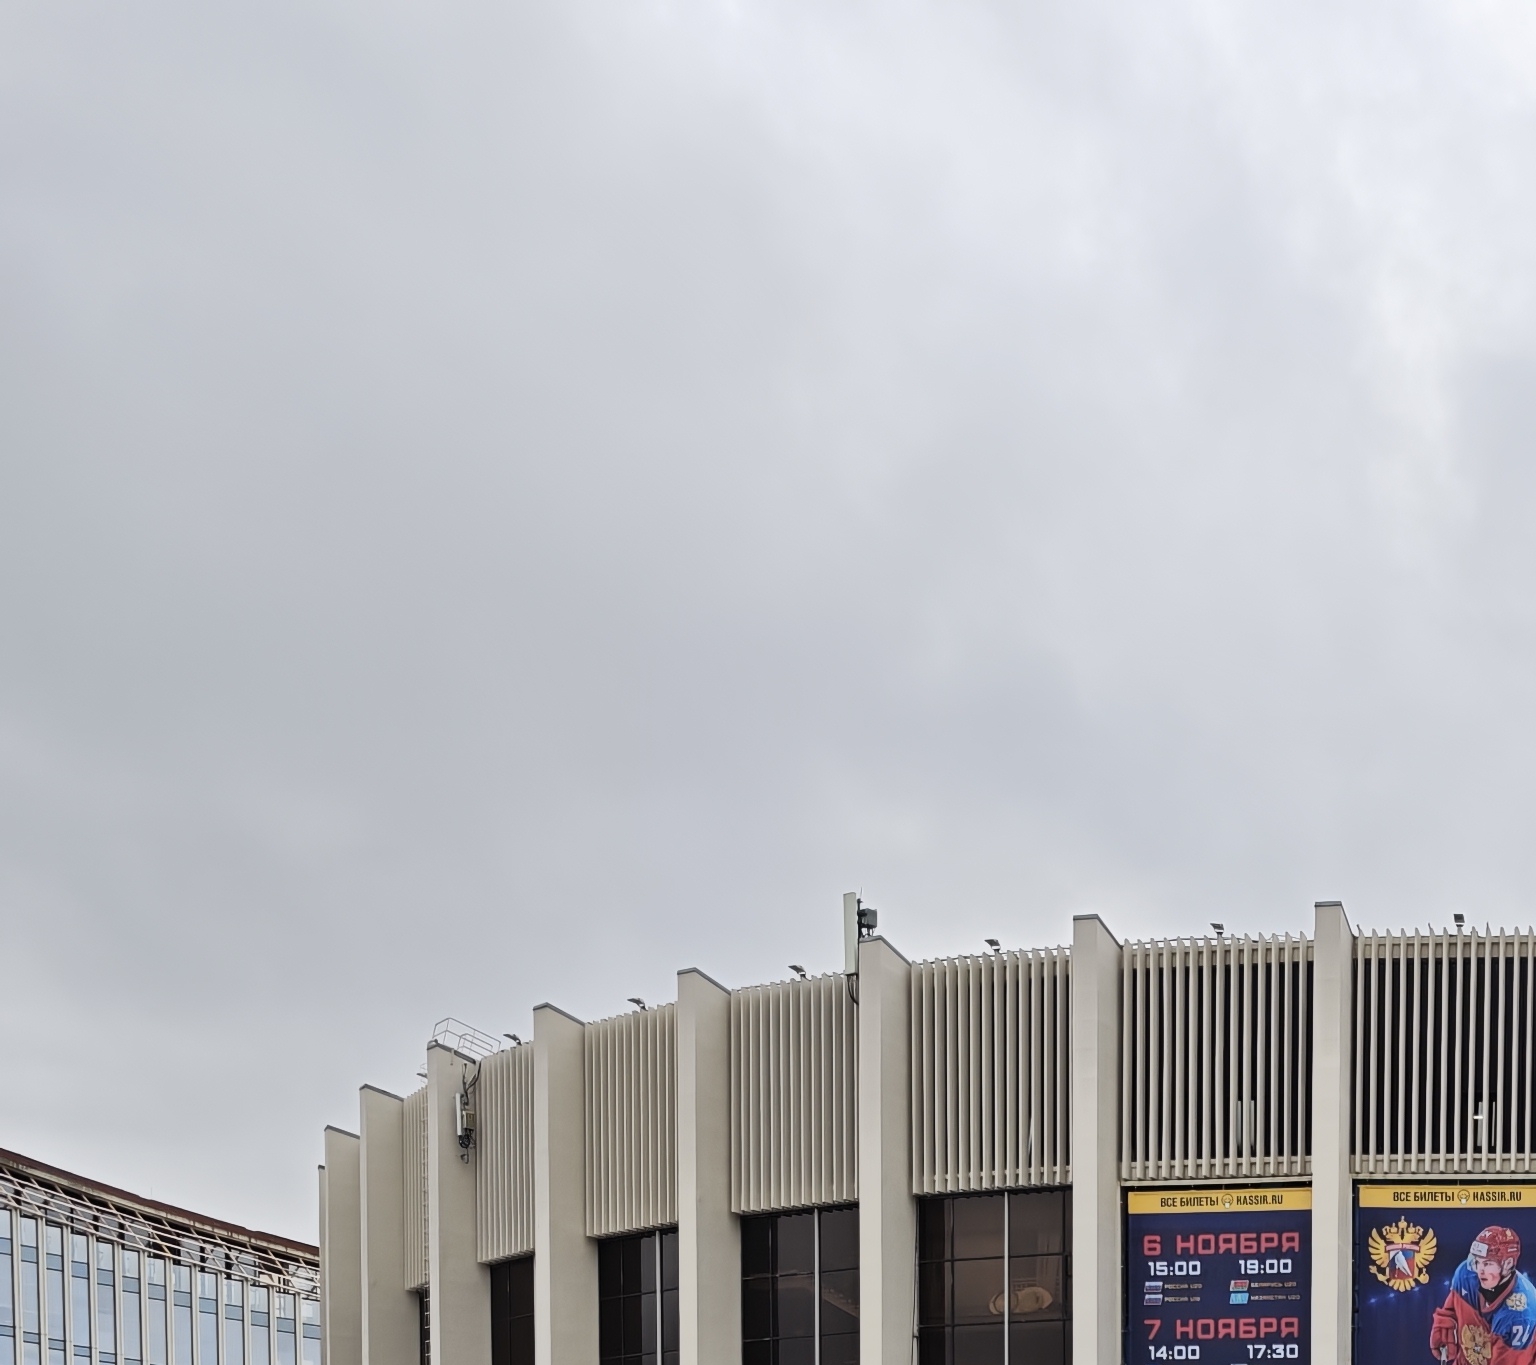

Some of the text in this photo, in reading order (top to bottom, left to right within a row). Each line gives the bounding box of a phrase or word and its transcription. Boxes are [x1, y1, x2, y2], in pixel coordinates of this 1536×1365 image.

[1160, 1194, 1283, 1207] ВСЕ БИЛЕТЫ KASSIR.RU
[1393, 1191, 1522, 1202] ВСЕ БИЛЕТЫ KASSIR.RU
[1143, 1232, 1300, 1256] 6 НОЯБРЯ
[1148, 1261, 1201, 1276] 15:00
[1238, 1259, 1292, 1274] 19:00
[1143, 1317, 1299, 1340] 7 НОЯБРЯ
[1149, 1345, 1200, 1360] 14:00
[1246, 1344, 1299, 1359] 17:30
